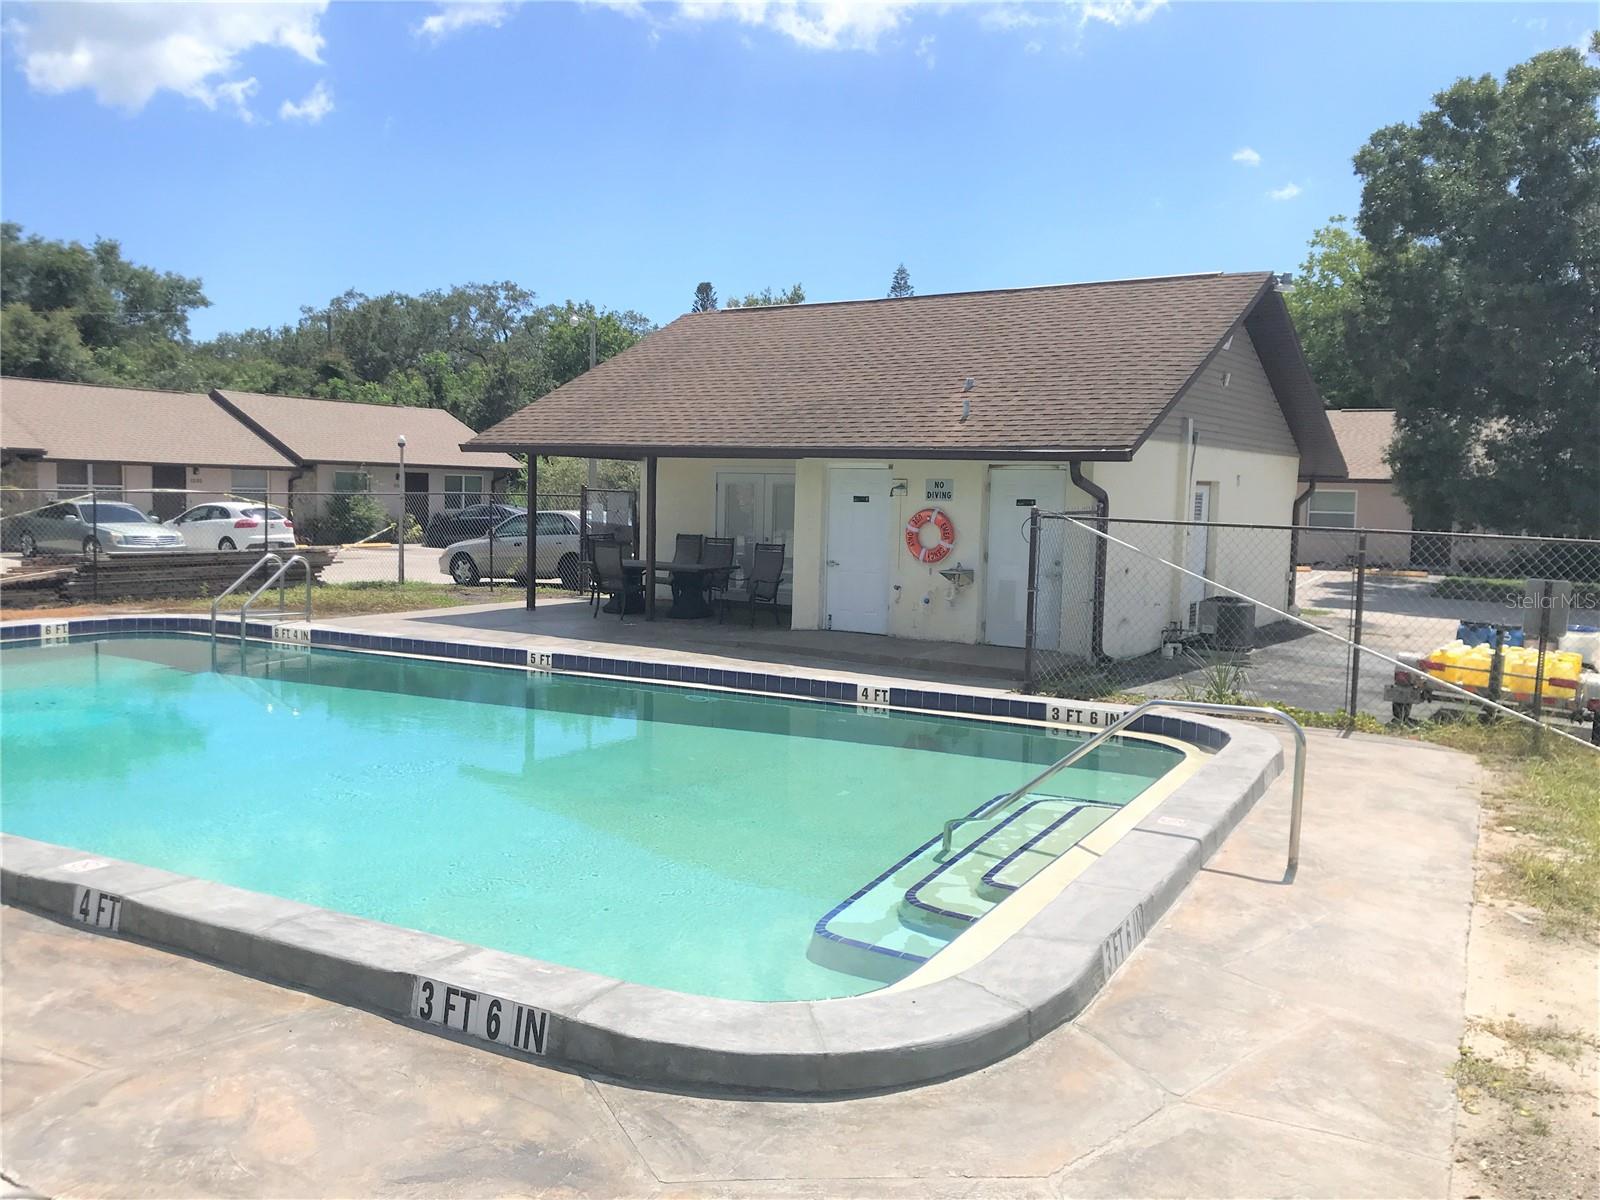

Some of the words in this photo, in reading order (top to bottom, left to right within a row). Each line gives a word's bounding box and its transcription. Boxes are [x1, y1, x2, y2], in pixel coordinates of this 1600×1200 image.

[934, 481, 945, 489] NO
[927, 491, 952, 500] DIVING
[912, 514, 923, 525] USE
[274, 628, 279, 638] 6
[293, 629, 298, 640] 4
[530, 653, 536, 664] 5
[861, 687, 869, 700] 4
[1052, 707, 1060, 721] 3
[1089, 711, 1098, 725] 6
[79, 888, 91, 923] 4
[95, 892, 121, 930] FT
[1105, 940, 1113, 976] 3
[1125, 919, 1133, 952] 6
[419, 980, 435, 1021] 3
[443, 986, 477, 1033] FT
[486, 999, 502, 1041] 6
[513, 1005, 547, 1054] IN
